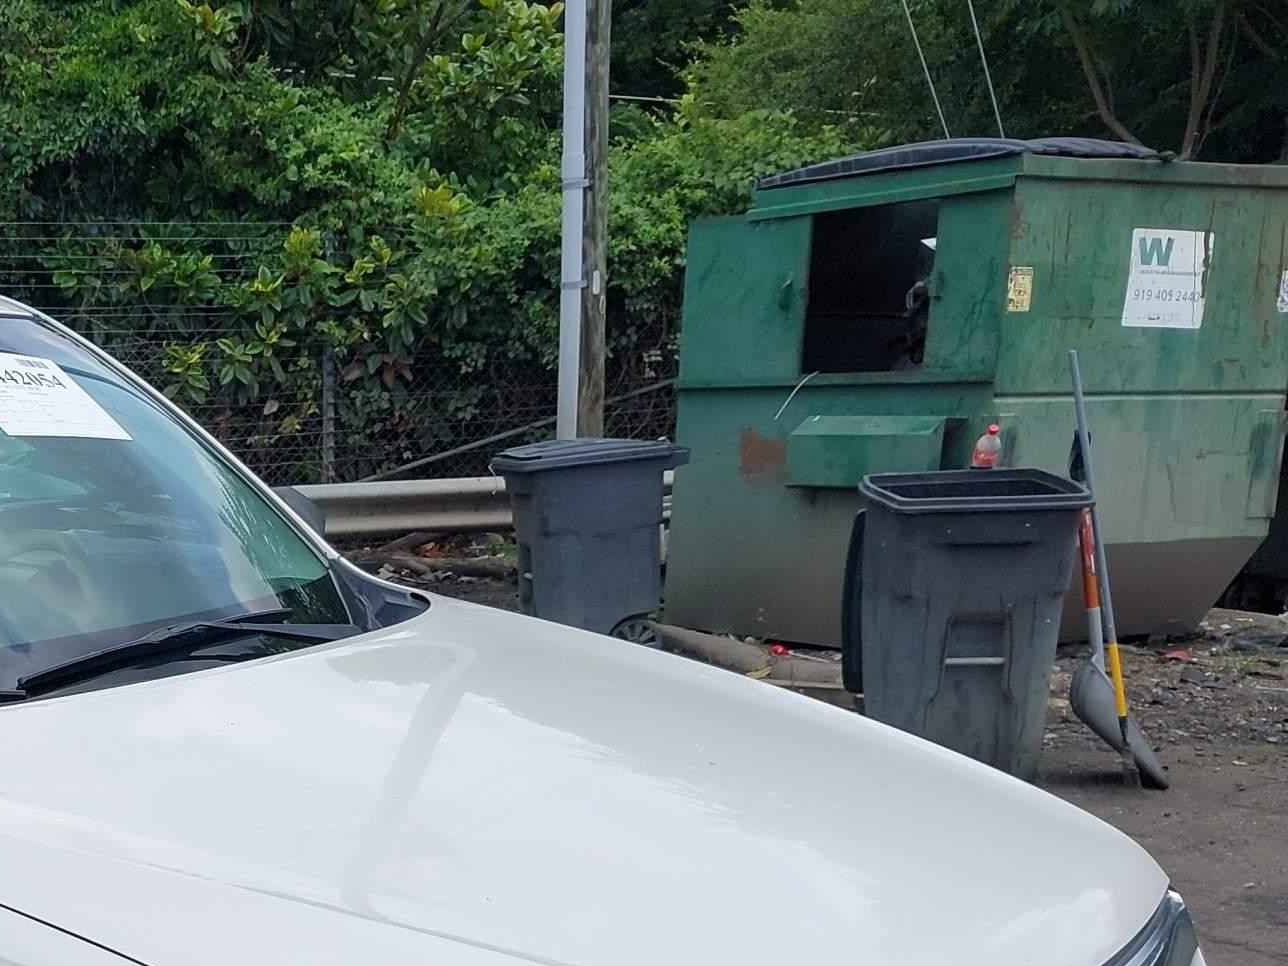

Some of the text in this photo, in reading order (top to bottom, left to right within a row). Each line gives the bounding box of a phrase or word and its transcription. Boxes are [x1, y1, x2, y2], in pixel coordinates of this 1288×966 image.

[1134, 288, 1200, 303] 919 405 2440
